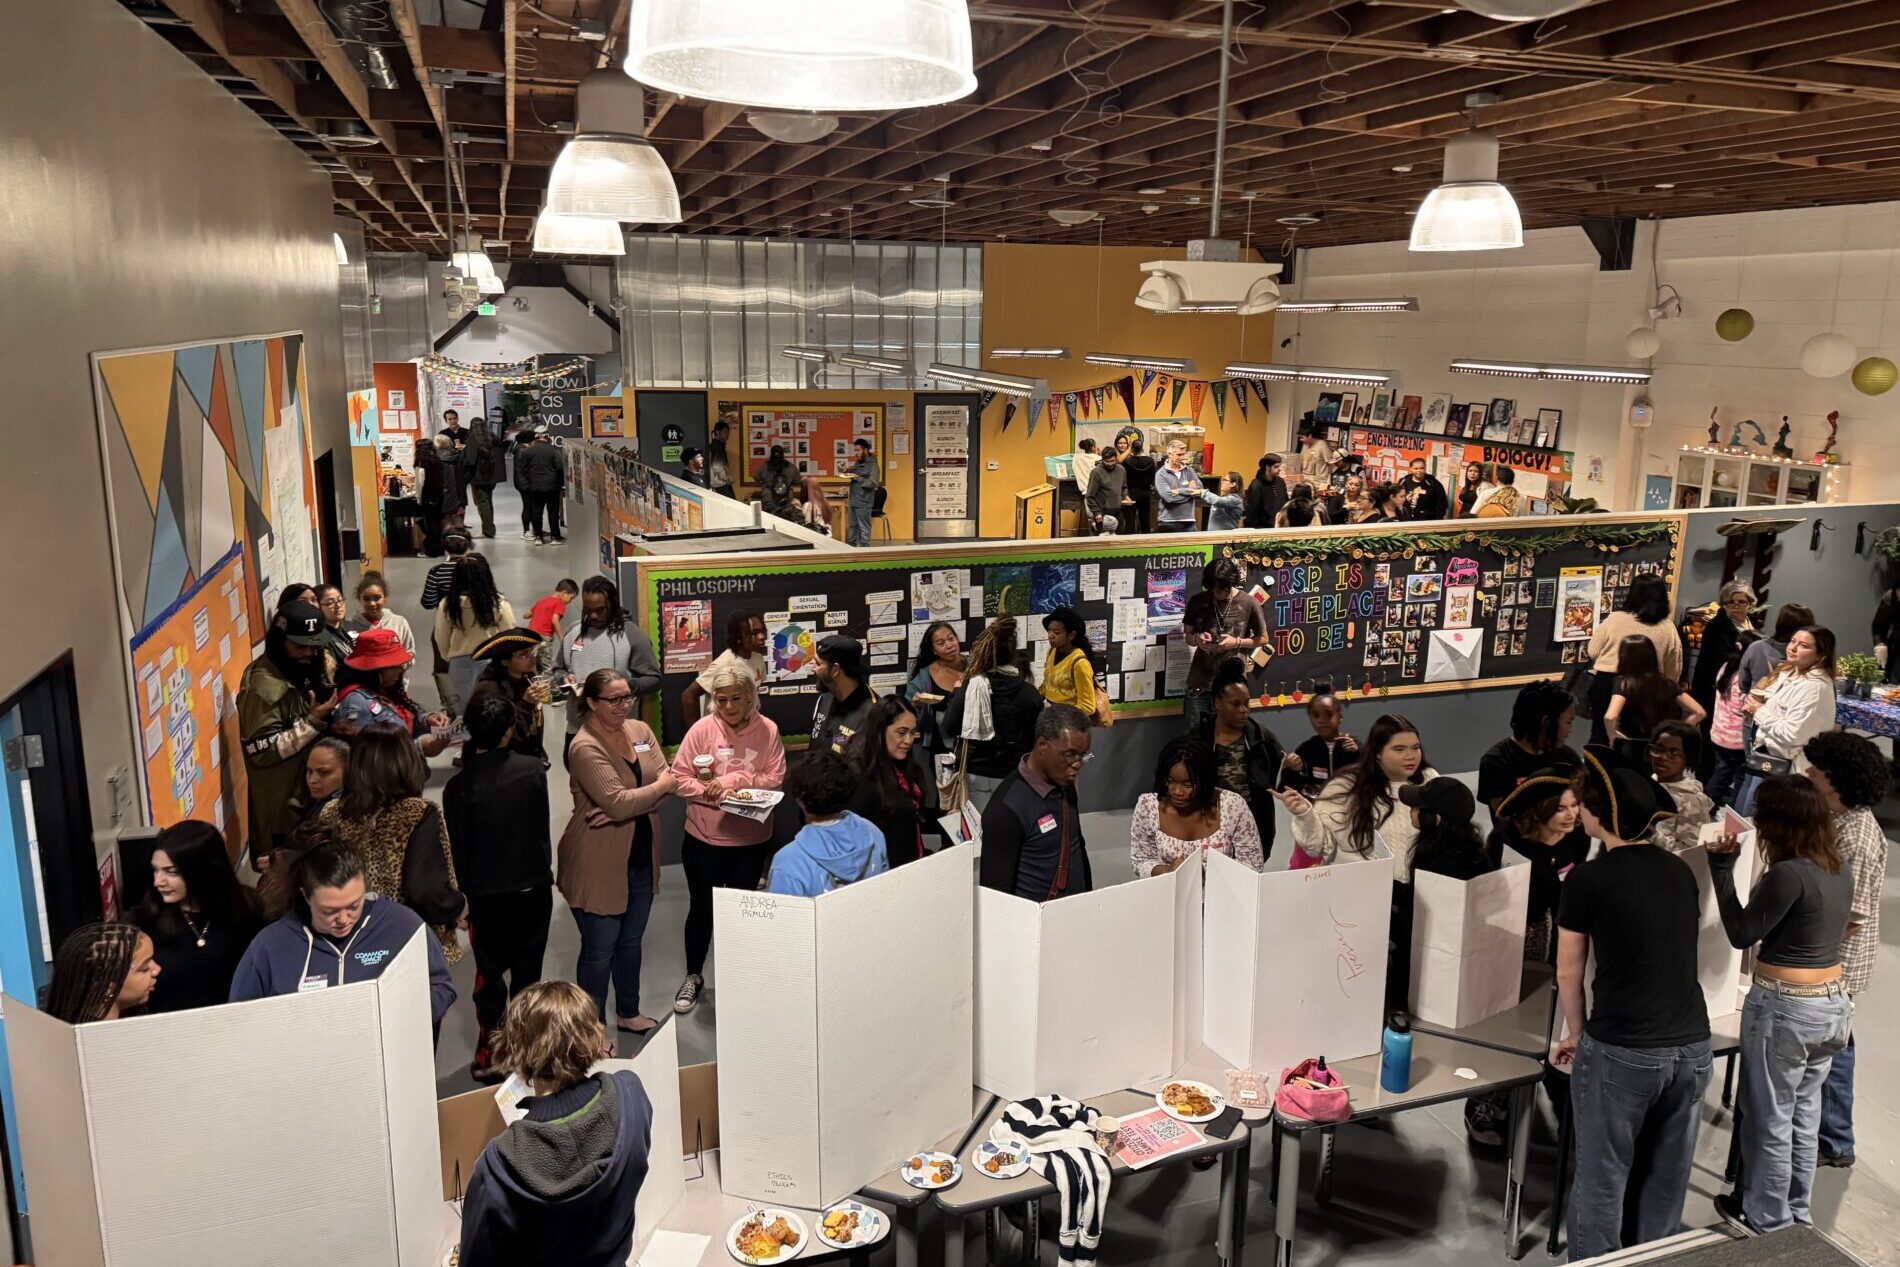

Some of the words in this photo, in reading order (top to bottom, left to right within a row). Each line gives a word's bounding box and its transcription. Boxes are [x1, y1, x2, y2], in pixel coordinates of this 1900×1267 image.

[541, 395, 563, 408] as
[542, 413, 573, 430] you
[1367, 432, 1425, 451] ENGINEERING
[1483, 446, 1551, 471] BIOLOGY!
[1144, 555, 1203, 570] ALGEBRA
[1335, 563, 1363, 591] IS
[660, 579, 757, 597] PHILOSOPHY
[305, 618, 317, 632] T
[1275, 628, 1305, 656] TO
[1317, 621, 1355, 652] BE!
[100, 857, 112, 886] STOP
[354, 949, 389, 959] COMMON
[361, 956, 382, 964] SPACE
[1120, 1125, 1136, 1136] TEST
[1132, 1136, 1154, 1154] SAMPLE
